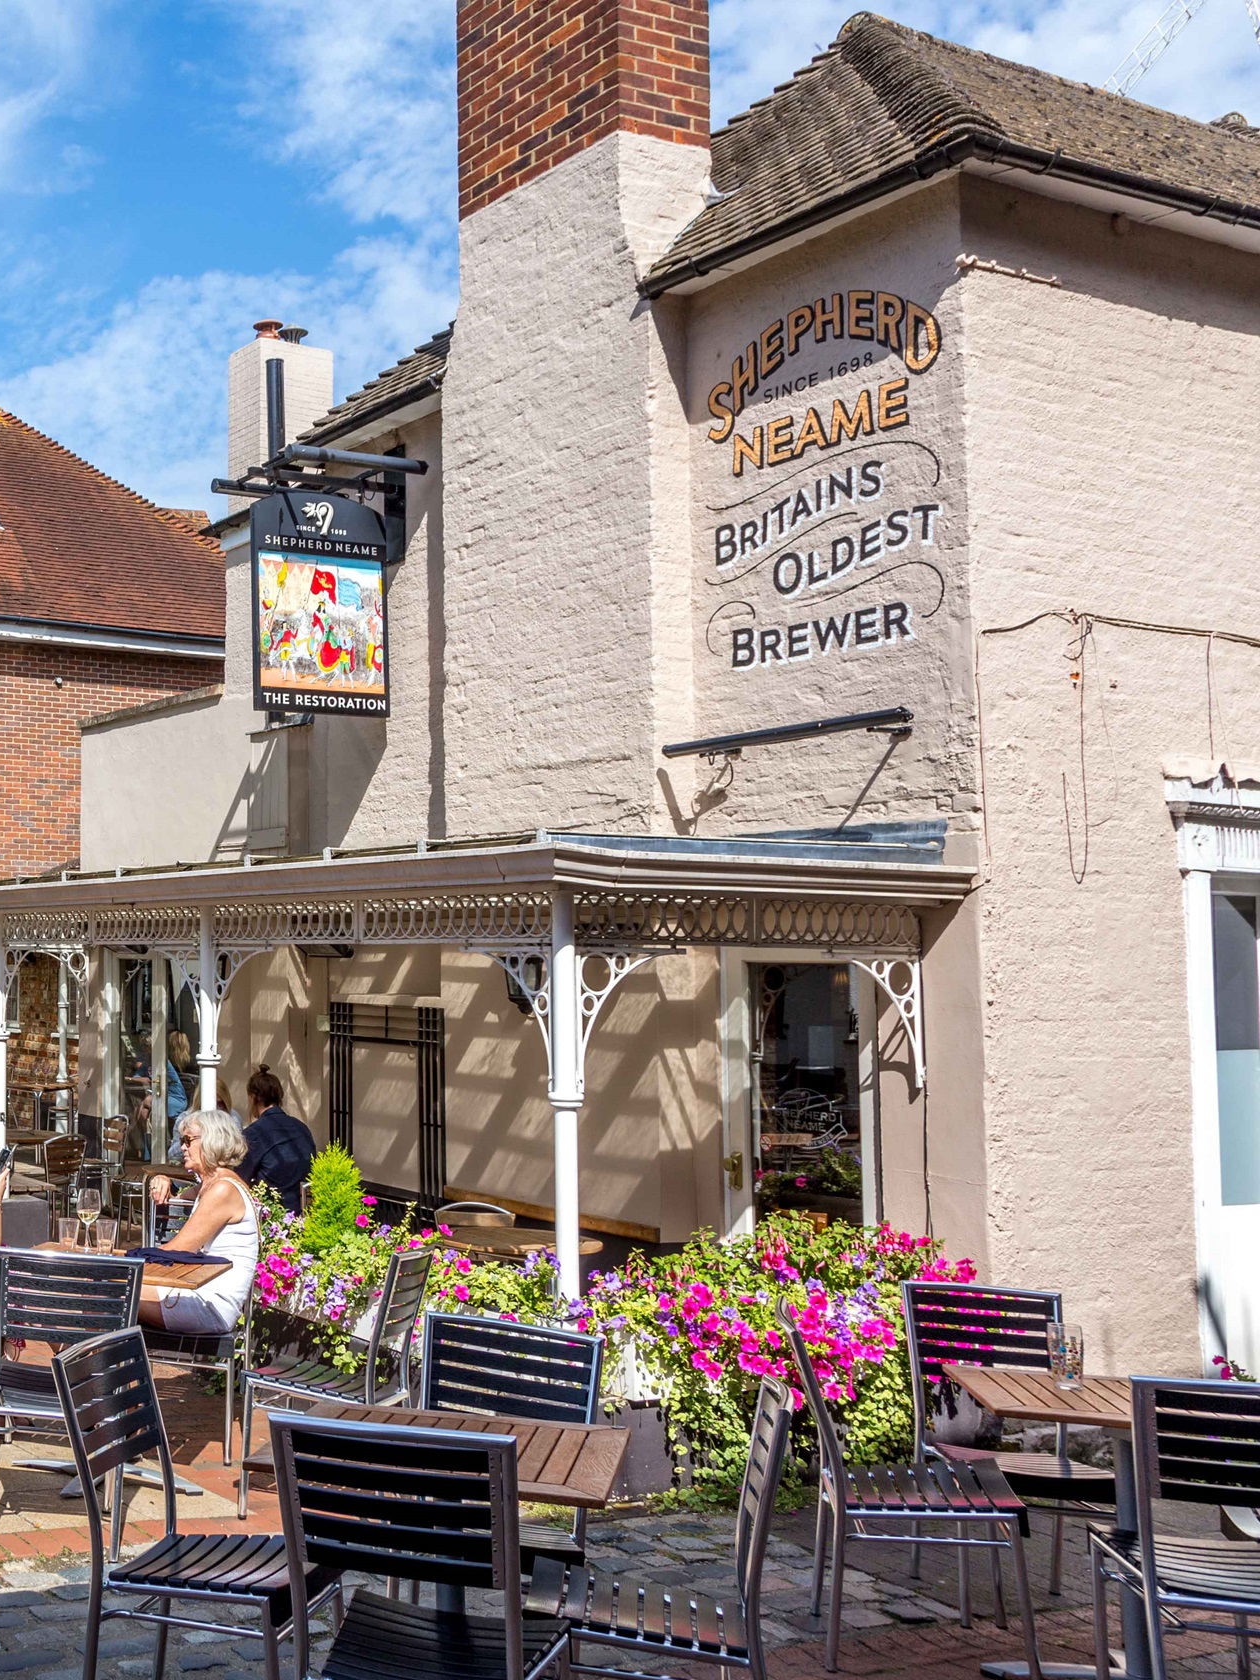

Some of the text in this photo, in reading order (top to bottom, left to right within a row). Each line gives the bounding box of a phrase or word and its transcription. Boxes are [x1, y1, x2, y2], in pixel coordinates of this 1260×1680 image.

[707, 289, 942, 444] SHEPHERD
[763, 352, 874, 404] SINCE 1698
[731, 377, 910, 477] NEAME
[295, 524, 348, 536] SINCE 1698
[714, 460, 889, 571] BRITAINS
[264, 534, 379, 556] SHEPHERD NEAME
[773, 504, 942, 599] OLDEST
[731, 601, 916, 672] BREWER
[262, 691, 387, 711] THE RESTORATION
[774, 1109, 837, 1123] SHEPHERD
[785, 1119, 827, 1133] NEAME
